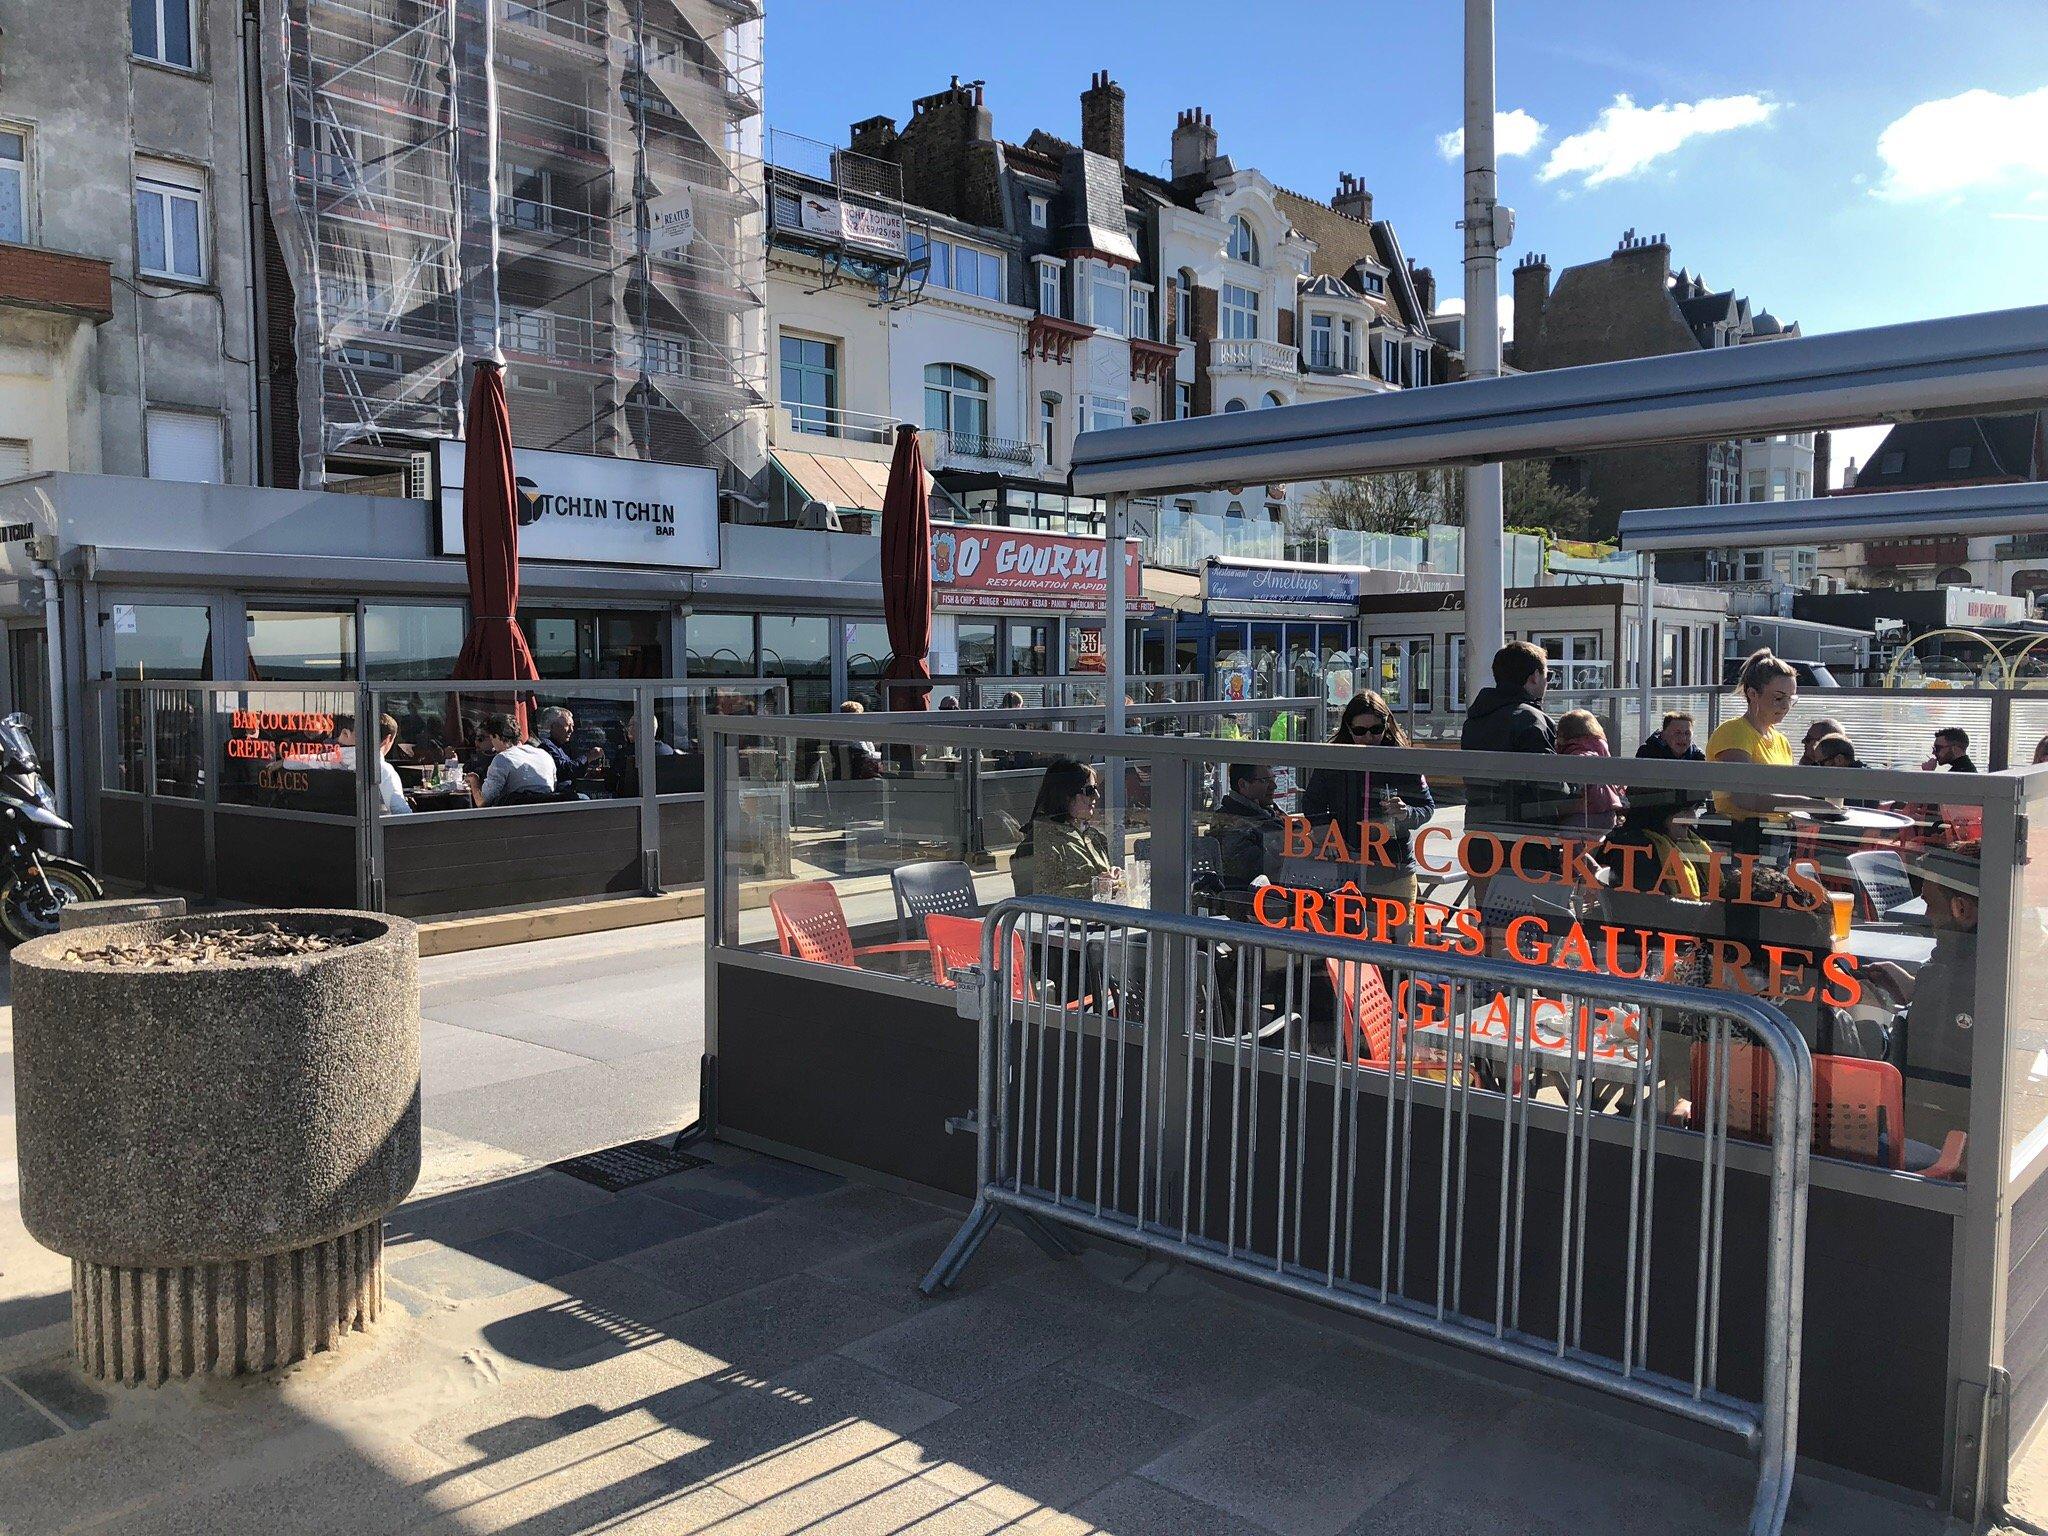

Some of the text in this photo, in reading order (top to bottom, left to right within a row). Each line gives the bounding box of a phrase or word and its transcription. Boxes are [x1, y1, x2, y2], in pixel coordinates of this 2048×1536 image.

[542, 494, 675, 524] TCHIN TCHIN
[655, 525, 676, 537] BAR
[996, 539, 1133, 580] GOURM
[986, 577, 1069, 590] RESTAURATION
[942, 594, 955, 604] FISH
[960, 595, 976, 605] CHIPS
[979, 596, 1000, 606] BURGER
[1003, 597, 1029, 607] SANDWICH
[1032, 598, 1048, 608] KEBAB
[1437, 593, 1462, 612] Le
[232, 710, 334, 732] BAR COCKTAILS
[228, 735, 342, 764] CRÊPES GAUFRES
[258, 769, 309, 791] GLACES
[1279, 815, 1828, 912] BAR COCKTAILS
[1253, 880, 1862, 1008] CRÊPES GAUFRES
[1398, 979, 1653, 1063] GLACES
